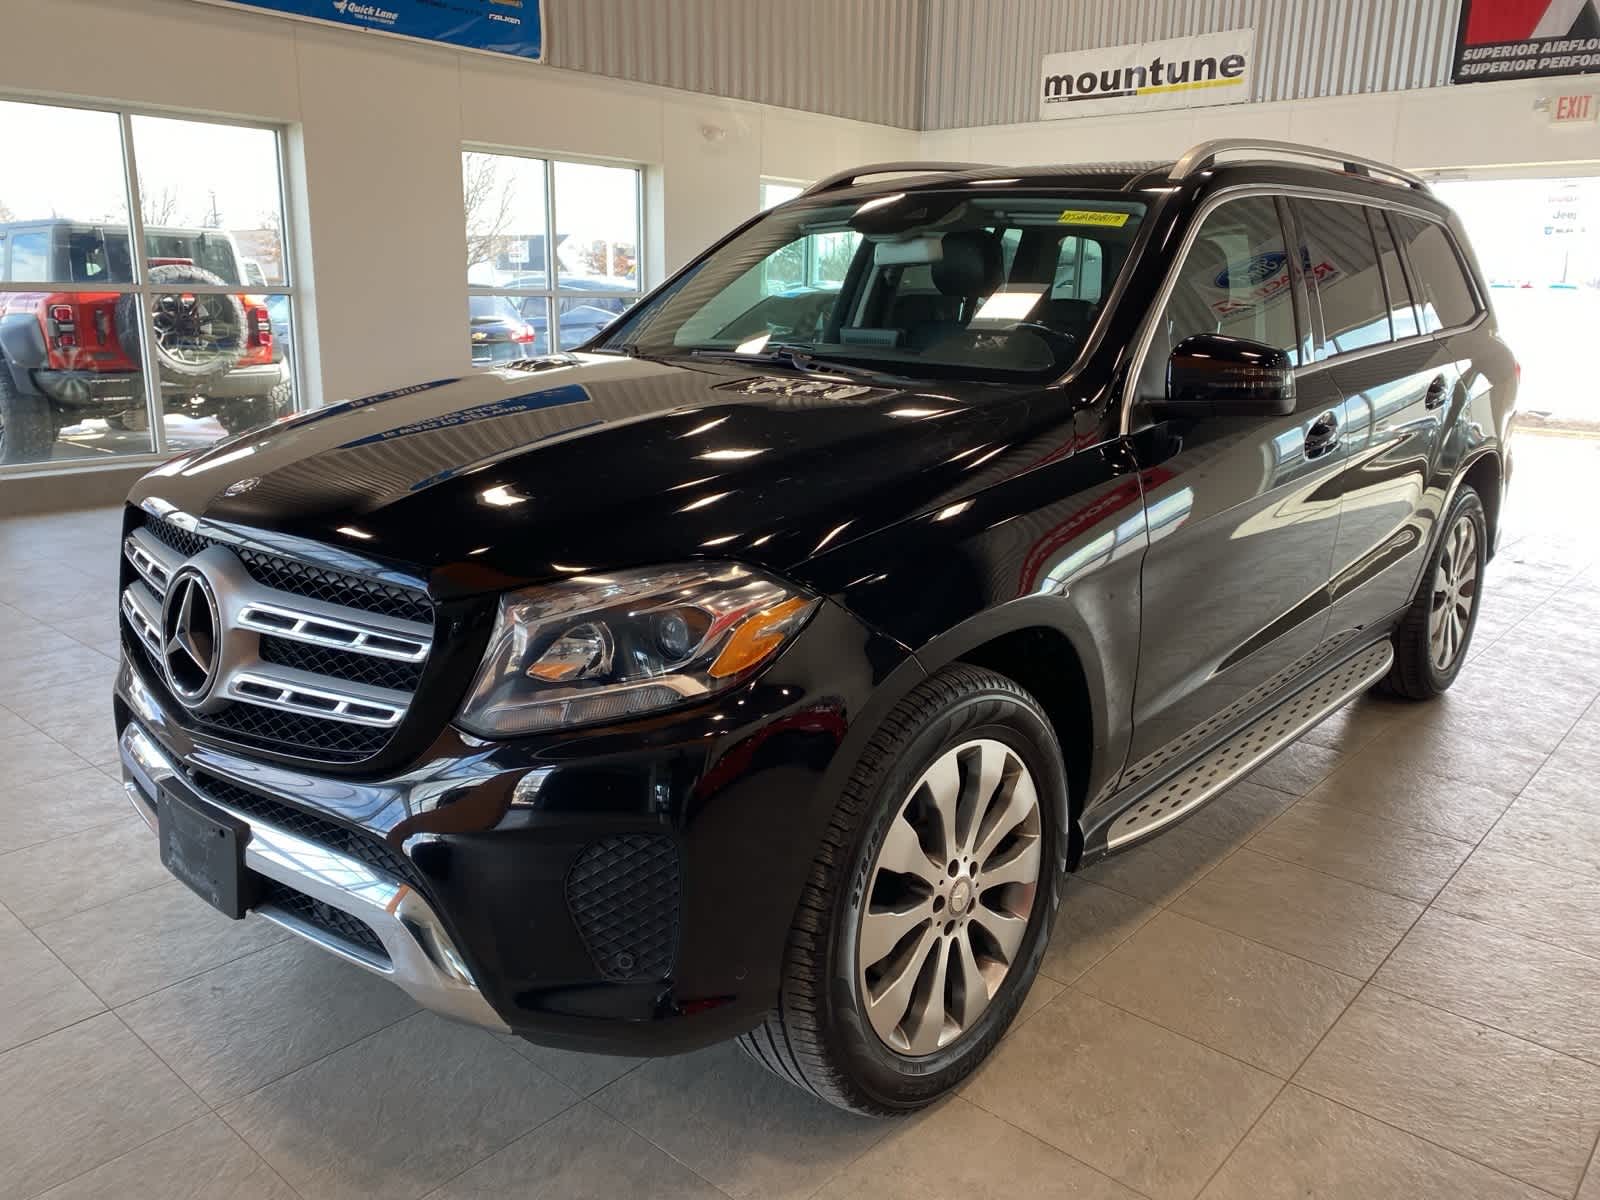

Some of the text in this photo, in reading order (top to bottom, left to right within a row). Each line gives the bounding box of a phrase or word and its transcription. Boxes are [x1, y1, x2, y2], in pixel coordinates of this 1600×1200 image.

[348, 2, 376, 15] Quick
[375, 7, 399, 20] Lane
[1463, 38, 1600, 61] SUPERIOR AIRFLO
[1044, 54, 1246, 96] mountune
[1460, 59, 1538, 76] SUPERIOR
[1556, 95, 1592, 120] EXIT
